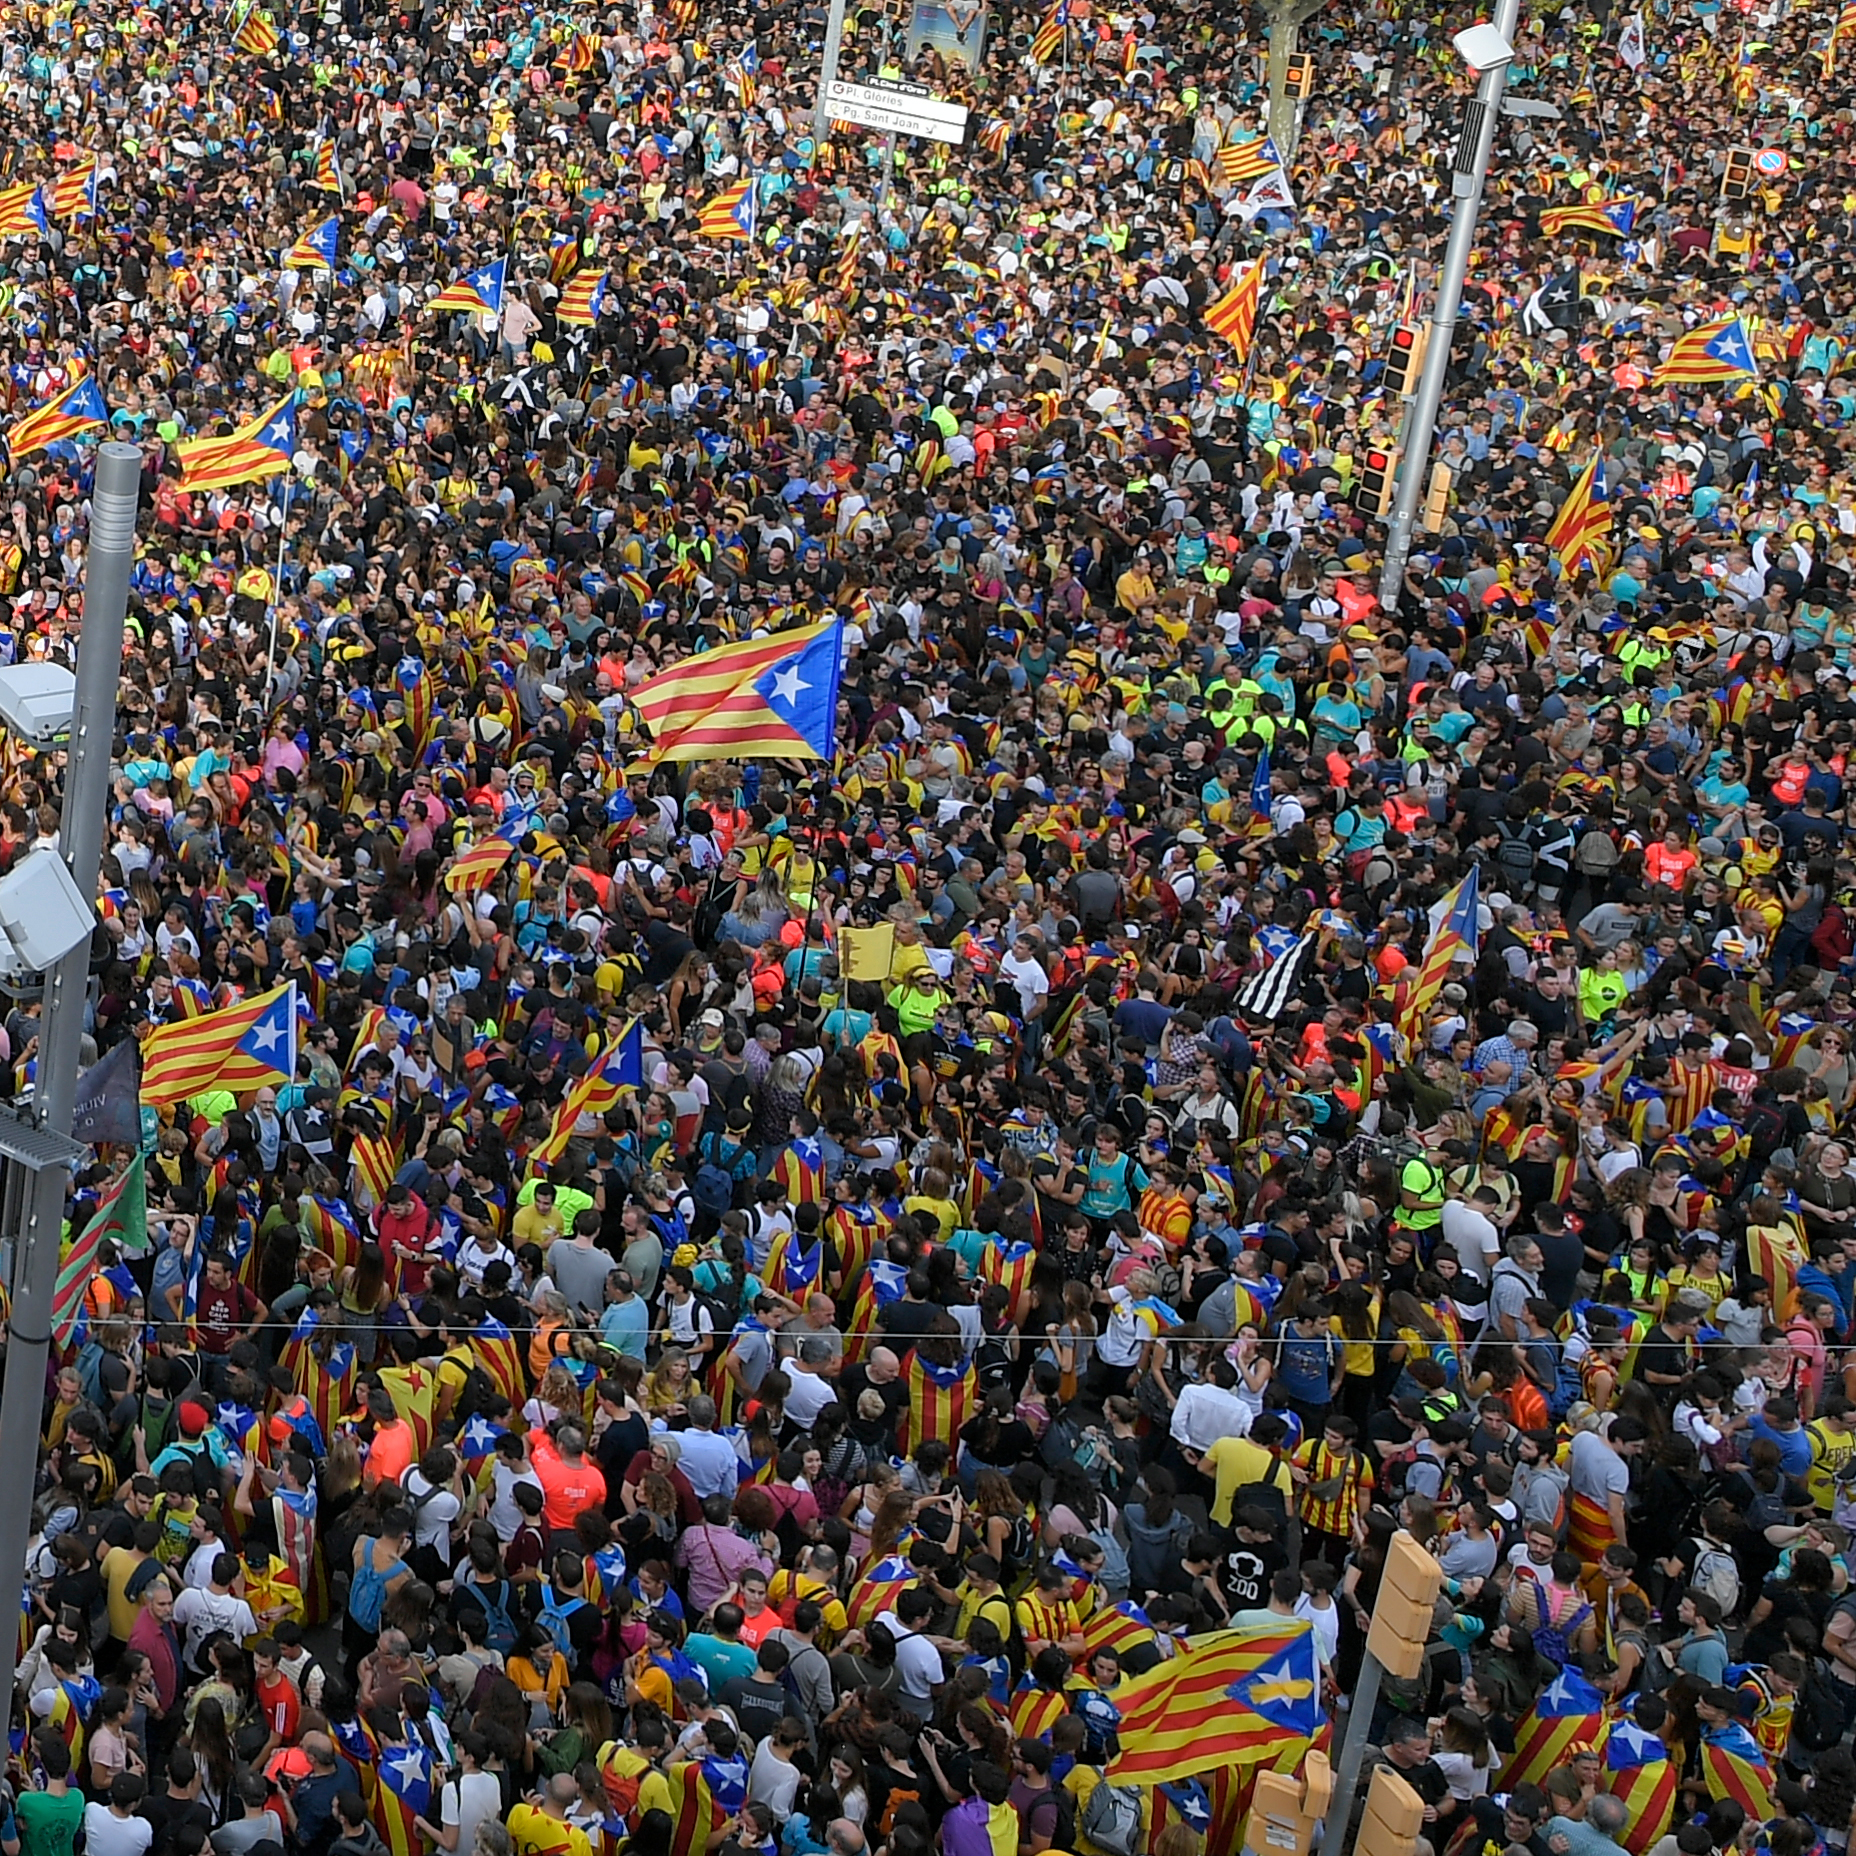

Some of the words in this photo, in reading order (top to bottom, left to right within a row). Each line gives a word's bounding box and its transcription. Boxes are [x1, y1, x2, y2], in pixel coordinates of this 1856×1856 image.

[846, 86, 860, 98] Pl.
[864, 90, 904, 107] Glòries
[843, 106, 860, 119] Pg.
[865, 110, 889, 124] Sant
[892, 116, 920, 130] Joan
[1227, 1575, 1259, 1600] ZOO
